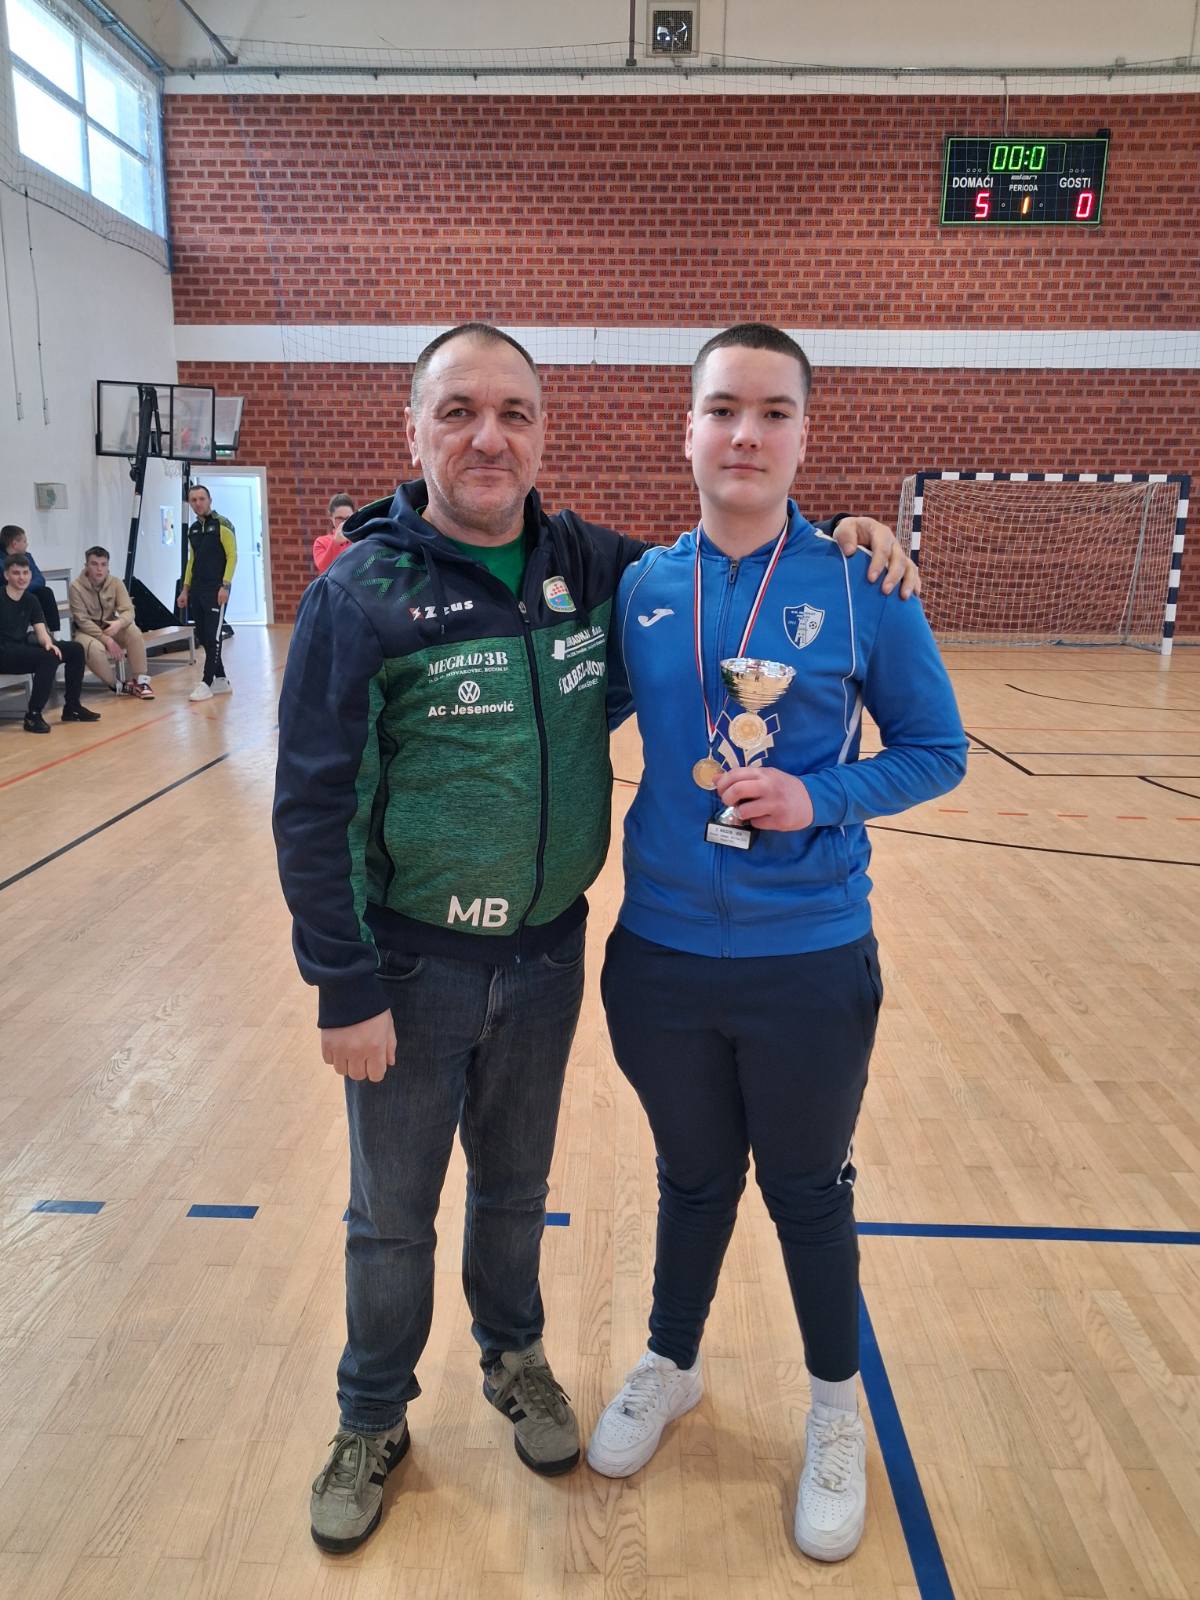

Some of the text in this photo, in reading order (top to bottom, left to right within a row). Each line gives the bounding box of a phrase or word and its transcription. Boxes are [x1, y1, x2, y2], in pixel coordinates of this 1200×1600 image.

[992, 146, 1046, 170] 00:0
[952, 175, 994, 188] DOMAĆI
[1008, 184, 1039, 192] PERIODA
[1059, 177, 1092, 189] GOSTI
[974, 192, 990, 218] 5
[1021, 196, 1031, 215] 1
[1075, 192, 1093, 218] 0
[427, 651, 509, 677] MEGRAD 3B
[427, 700, 514, 717] AC Jesenović
[447, 895, 509, 927] MB
